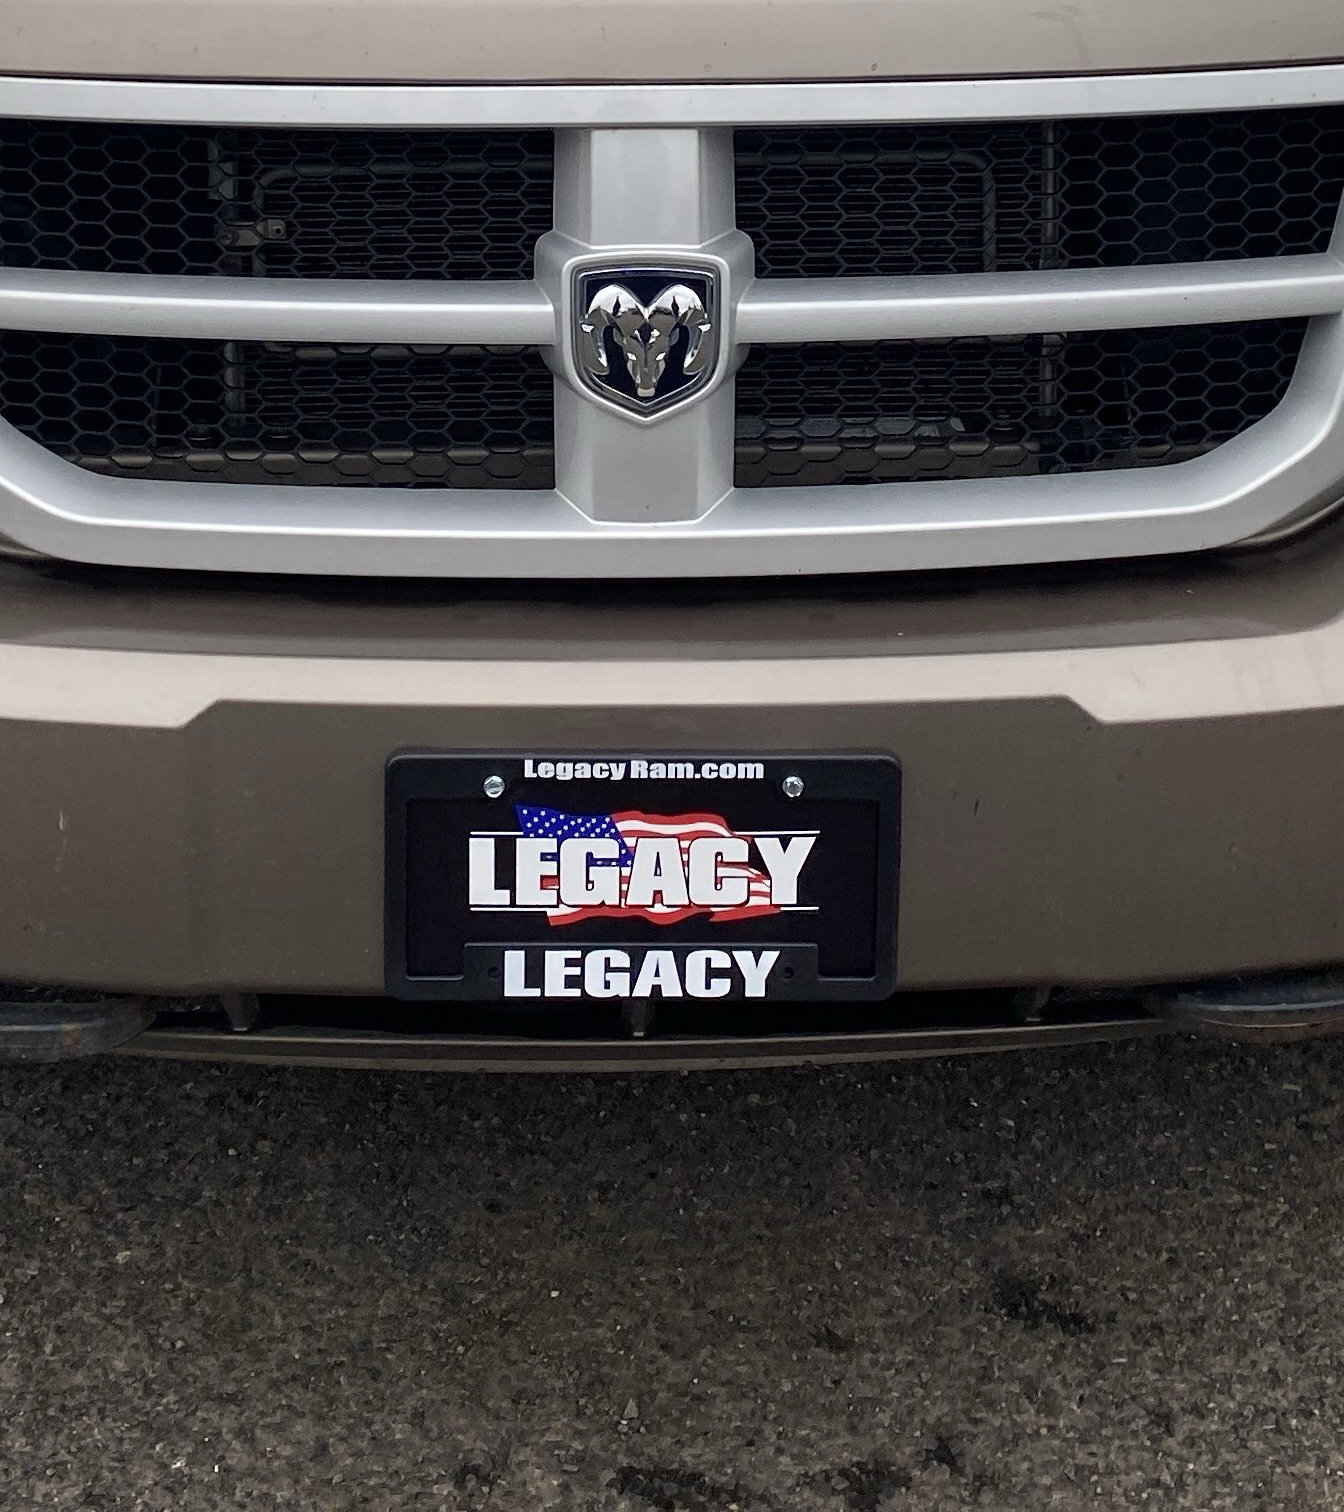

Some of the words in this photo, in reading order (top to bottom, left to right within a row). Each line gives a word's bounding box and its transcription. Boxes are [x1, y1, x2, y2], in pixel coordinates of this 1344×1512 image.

[523, 759, 627, 781] Legacy
[629, 759, 765, 780] Ram.com
[467, 836, 817, 908] LEGACY
[502, 949, 782, 998] LEGACY
